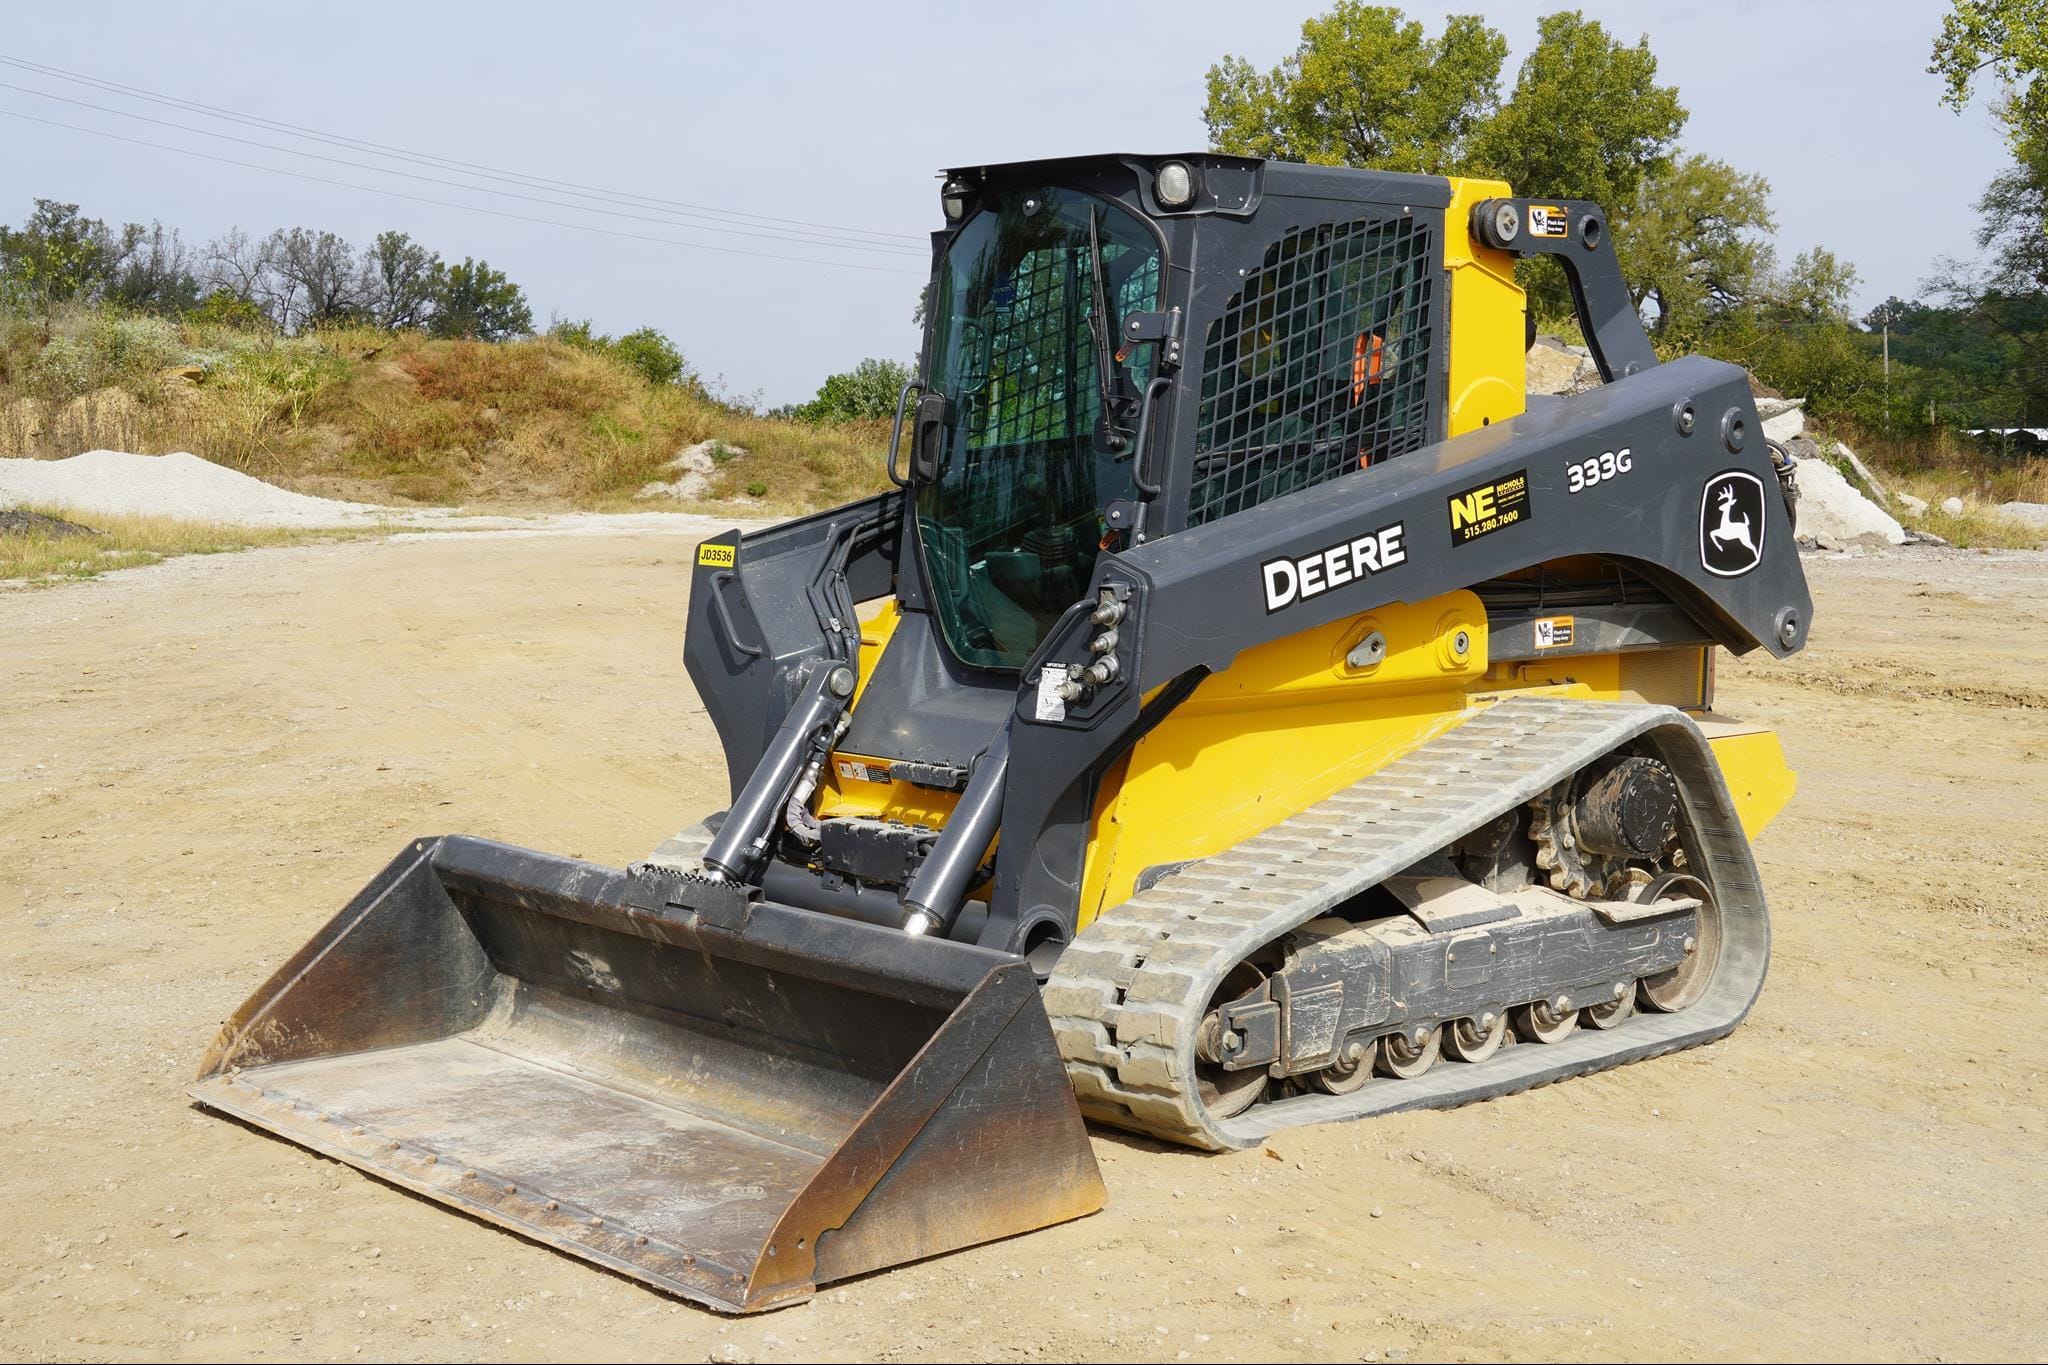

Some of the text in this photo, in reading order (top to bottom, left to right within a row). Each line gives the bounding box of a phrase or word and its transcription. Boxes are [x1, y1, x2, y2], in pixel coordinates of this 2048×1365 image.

[1496, 476, 1525, 493] NICHOLS
[1567, 447, 1632, 493] 333G
[1450, 485, 1497, 530] NE
[1464, 510, 1519, 539] 515.280.7600
[701, 549, 732, 562] JD3536
[1263, 523, 1406, 611] DEERE
